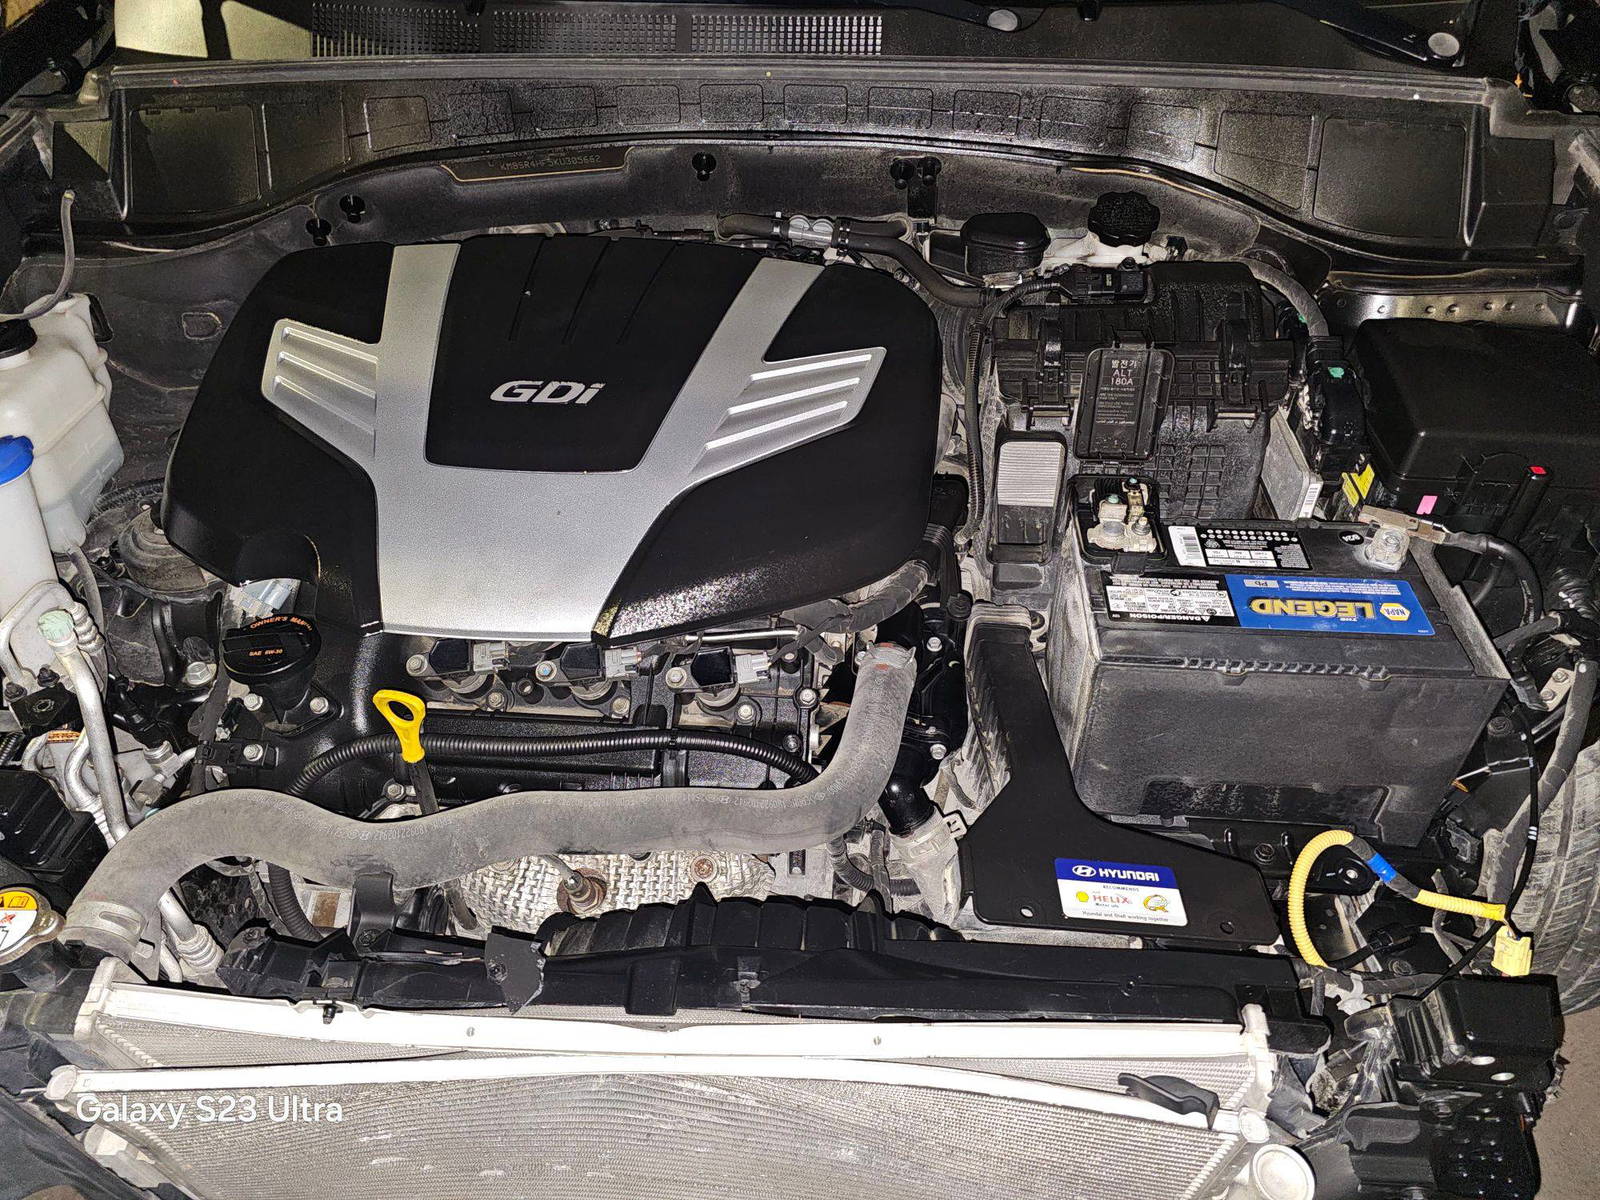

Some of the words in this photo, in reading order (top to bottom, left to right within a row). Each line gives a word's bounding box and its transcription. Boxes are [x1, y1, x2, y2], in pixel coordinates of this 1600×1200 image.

[1113, 369, 1132, 377] ALT
[1111, 377, 1133, 386] 180A
[489, 380, 607, 404] GDi
[1249, 598, 1375, 620] LEGEND
[1383, 607, 1407, 616] NAPA
[1129, 612, 1202, 621] DANGER/POISON
[1098, 867, 1160, 882] HYUNDAI
[1092, 894, 1130, 904] HELIX
